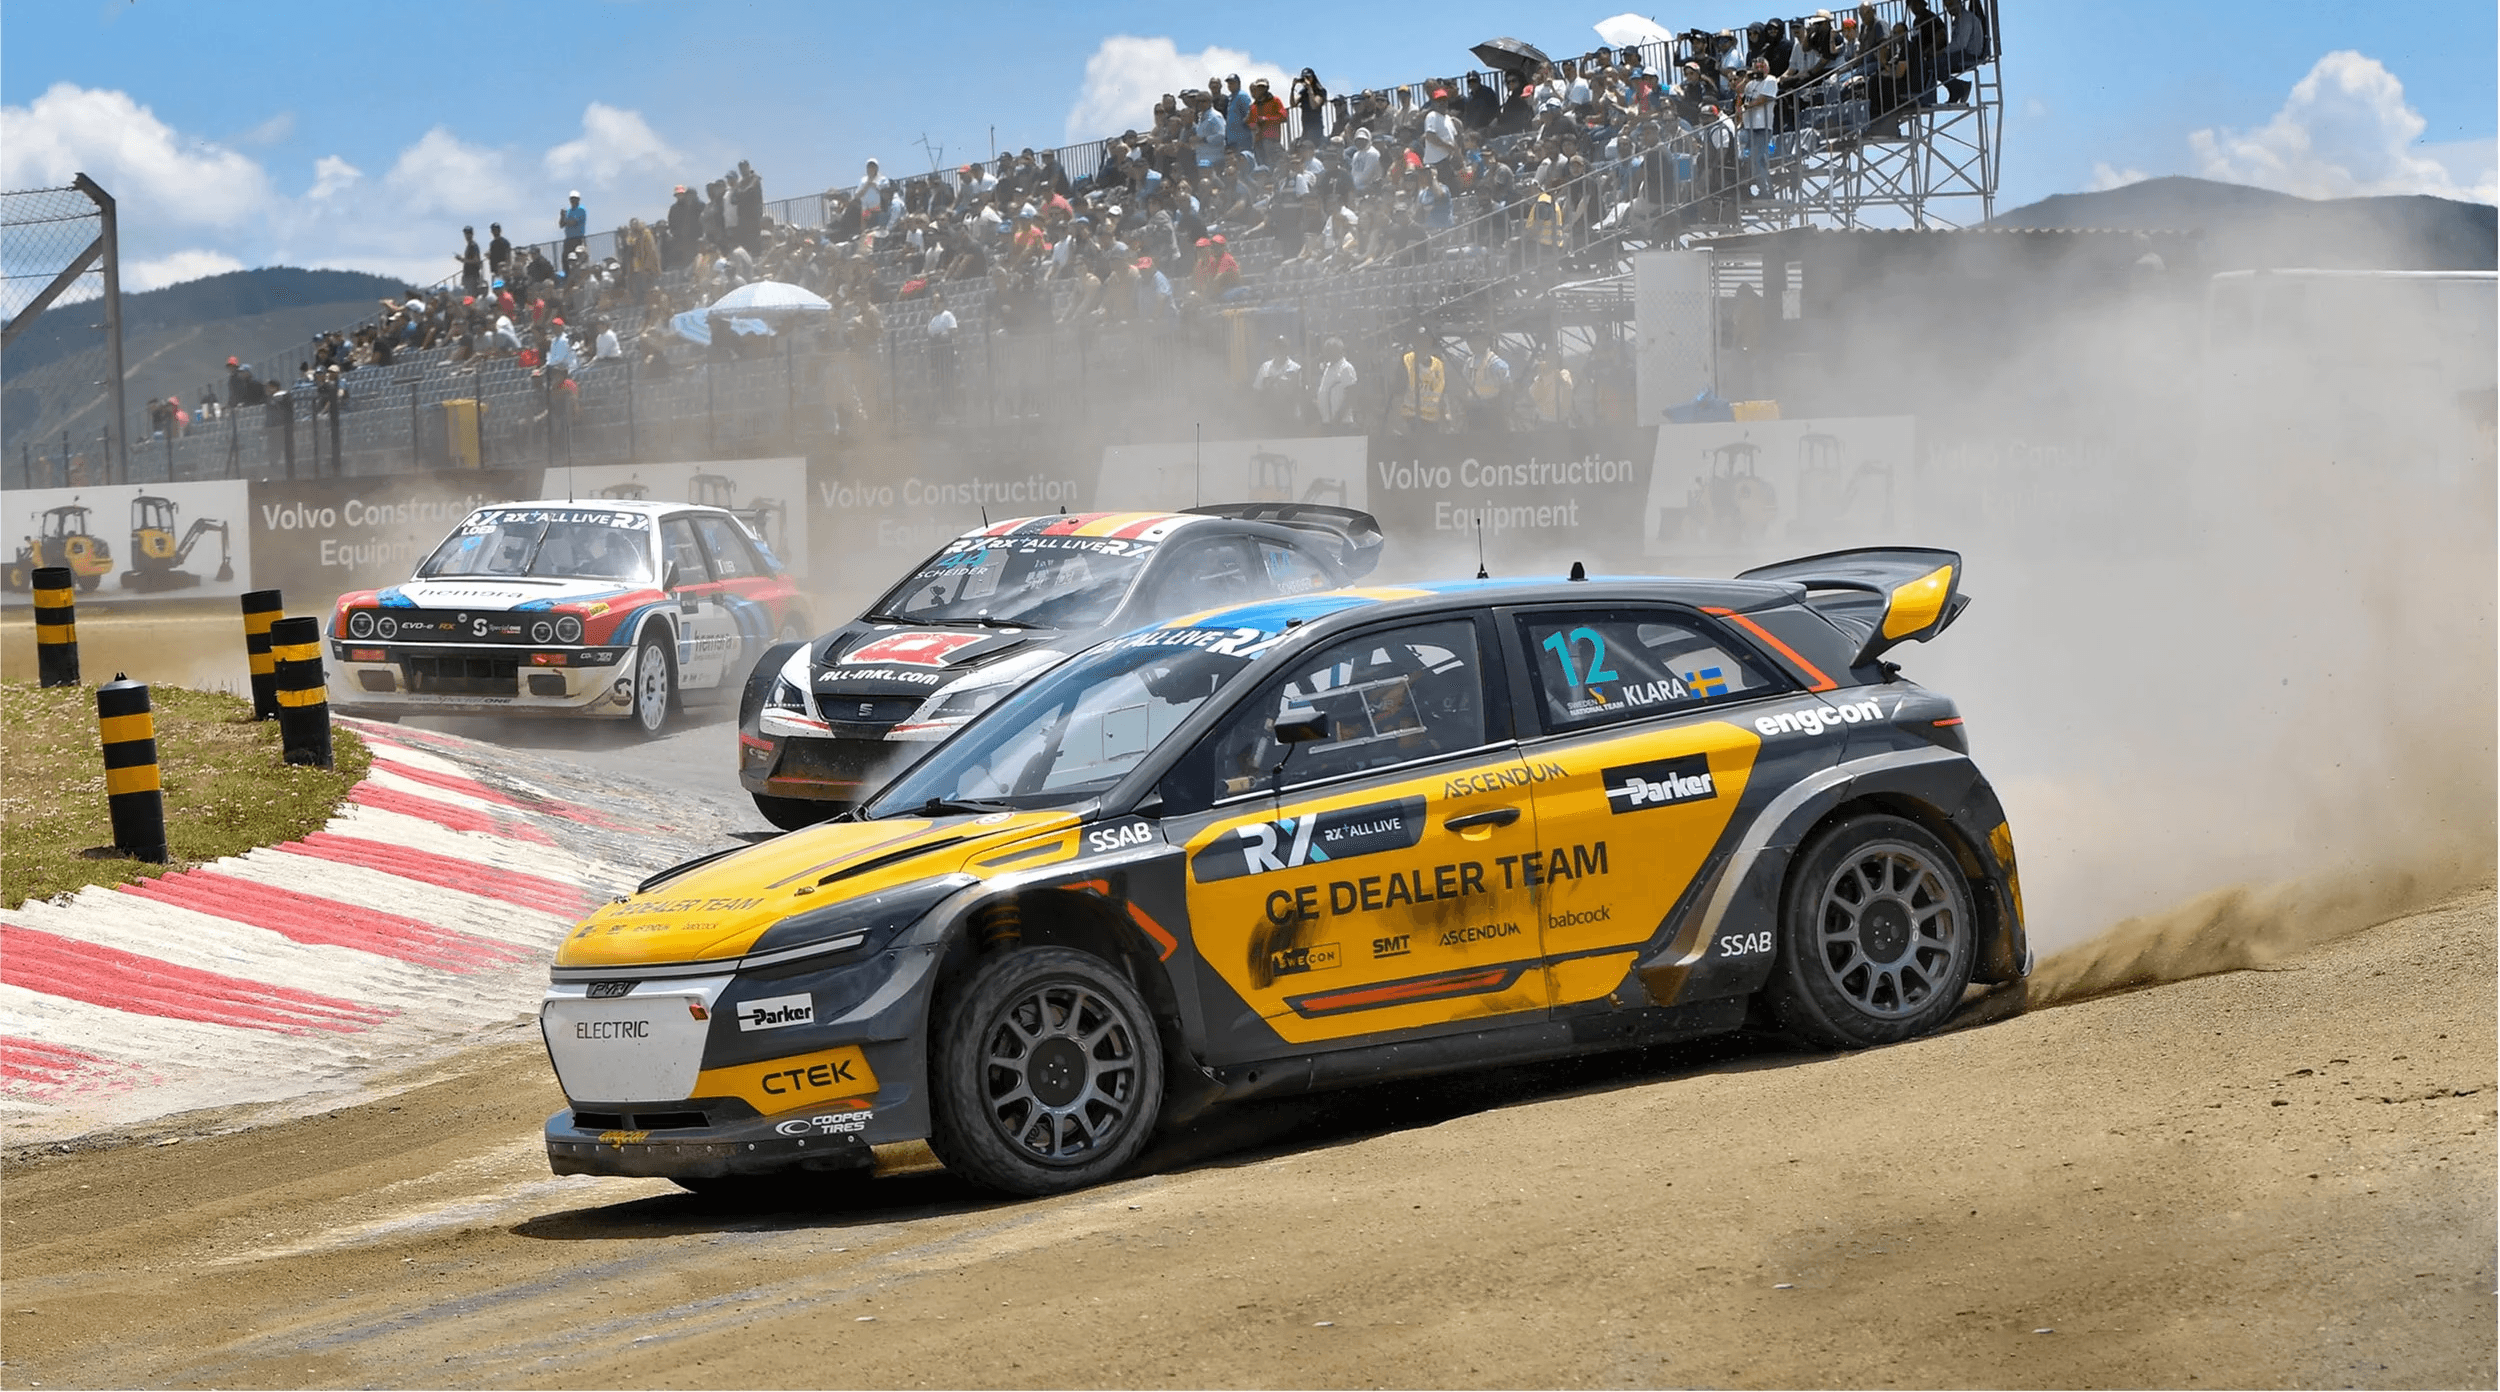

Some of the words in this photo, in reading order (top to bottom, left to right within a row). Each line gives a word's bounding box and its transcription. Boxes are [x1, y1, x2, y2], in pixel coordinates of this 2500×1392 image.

[1378, 460, 1451, 490] Volvo
[1460, 453, 1634, 488] Construction
[820, 480, 894, 508] Volvo
[903, 473, 1078, 506] Construction
[262, 502, 337, 530] Volvo
[572, 513, 611, 525] LIVE
[1435, 500, 1580, 536] Equipment
[461, 526, 497, 536] LOEB
[1024, 539, 1058, 548] ALL
[1061, 540, 1106, 551] LIVE
[914, 567, 988, 580] SCHEIDER
[1543, 626, 1618, 688] 12
[1622, 679, 1688, 708] KLARA
[1755, 698, 1884, 736] engcon
[1443, 763, 1570, 799] ASCENDUM
[1606, 772, 1713, 805] Parker
[1088, 821, 1153, 852] SSAB
[1236, 813, 1331, 874] RX
[1350, 824, 1373, 837] ALL
[1374, 817, 1402, 833] LIVE
[1265, 884, 1320, 926] CE
[1329, 860, 1486, 916] DEALER
[1495, 841, 1609, 891] TEAM
[1548, 905, 1611, 930] babcock
[1372, 934, 1410, 954] SMT
[1439, 922, 1521, 947] ASCENDUM
[1720, 931, 1772, 957] SSAB
[738, 1004, 812, 1027] Parker
[576, 1020, 650, 1040] ELECTRIC
[761, 1059, 857, 1095] CTEK
[811, 1110, 874, 1126] COOPER
[821, 1121, 866, 1134] TIRES
